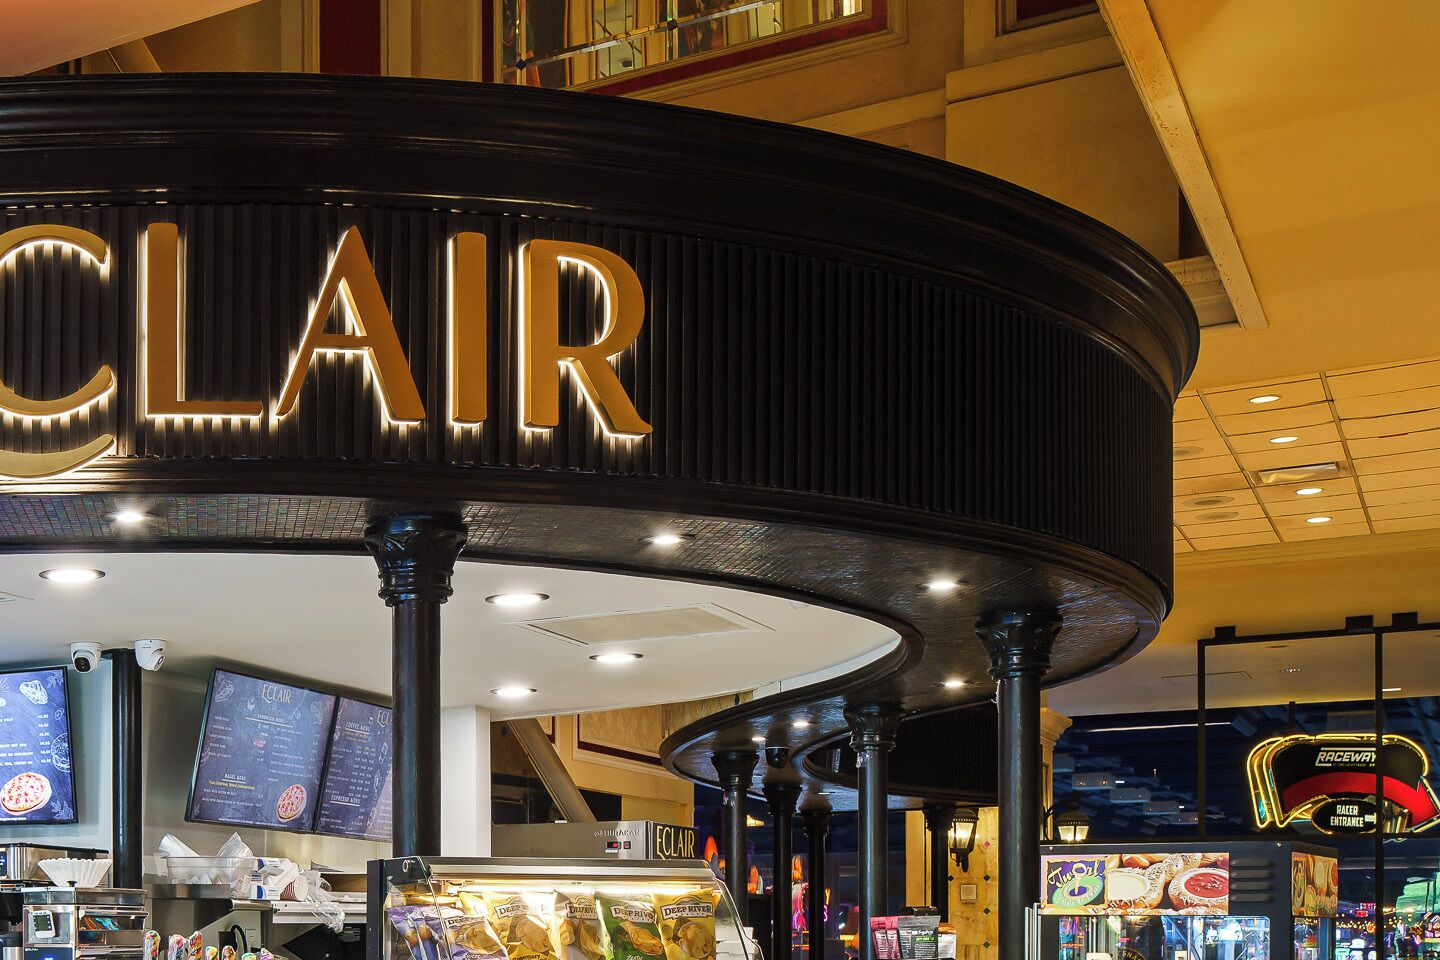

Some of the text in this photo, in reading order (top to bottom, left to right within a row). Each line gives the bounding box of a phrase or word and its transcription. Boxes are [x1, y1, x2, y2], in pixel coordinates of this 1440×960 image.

[262, 684, 292, 704] ECLAIR
[1317, 751, 1376, 762] RACEWAY
[1336, 805, 1359, 815] RACER
[1330, 816, 1364, 827] ENTRANCE
[656, 826, 695, 860] ECLAIR
[664, 905, 713, 916] DEEP RIVER
